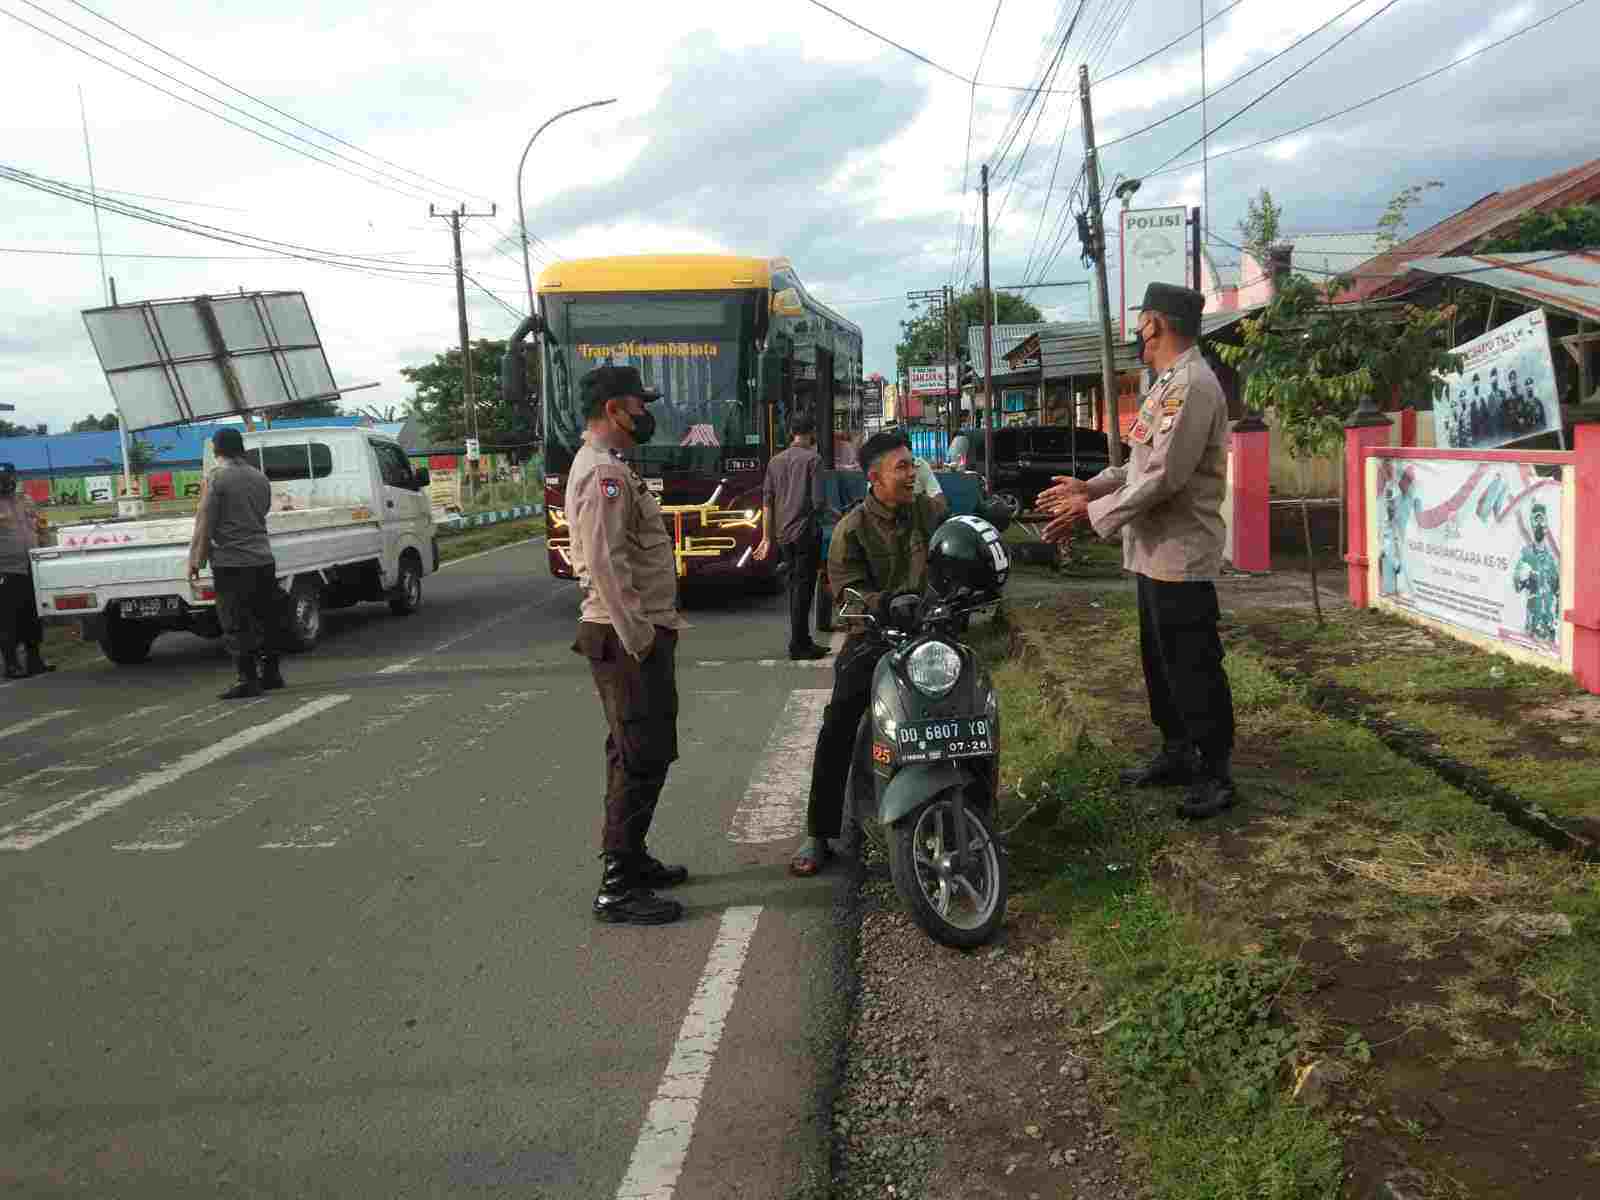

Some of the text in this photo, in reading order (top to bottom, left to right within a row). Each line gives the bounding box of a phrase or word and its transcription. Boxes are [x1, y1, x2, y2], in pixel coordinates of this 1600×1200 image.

[1127, 214, 1181, 229] POLISI
[900, 728, 918, 743] DD
[926, 723, 958, 740] 6807
